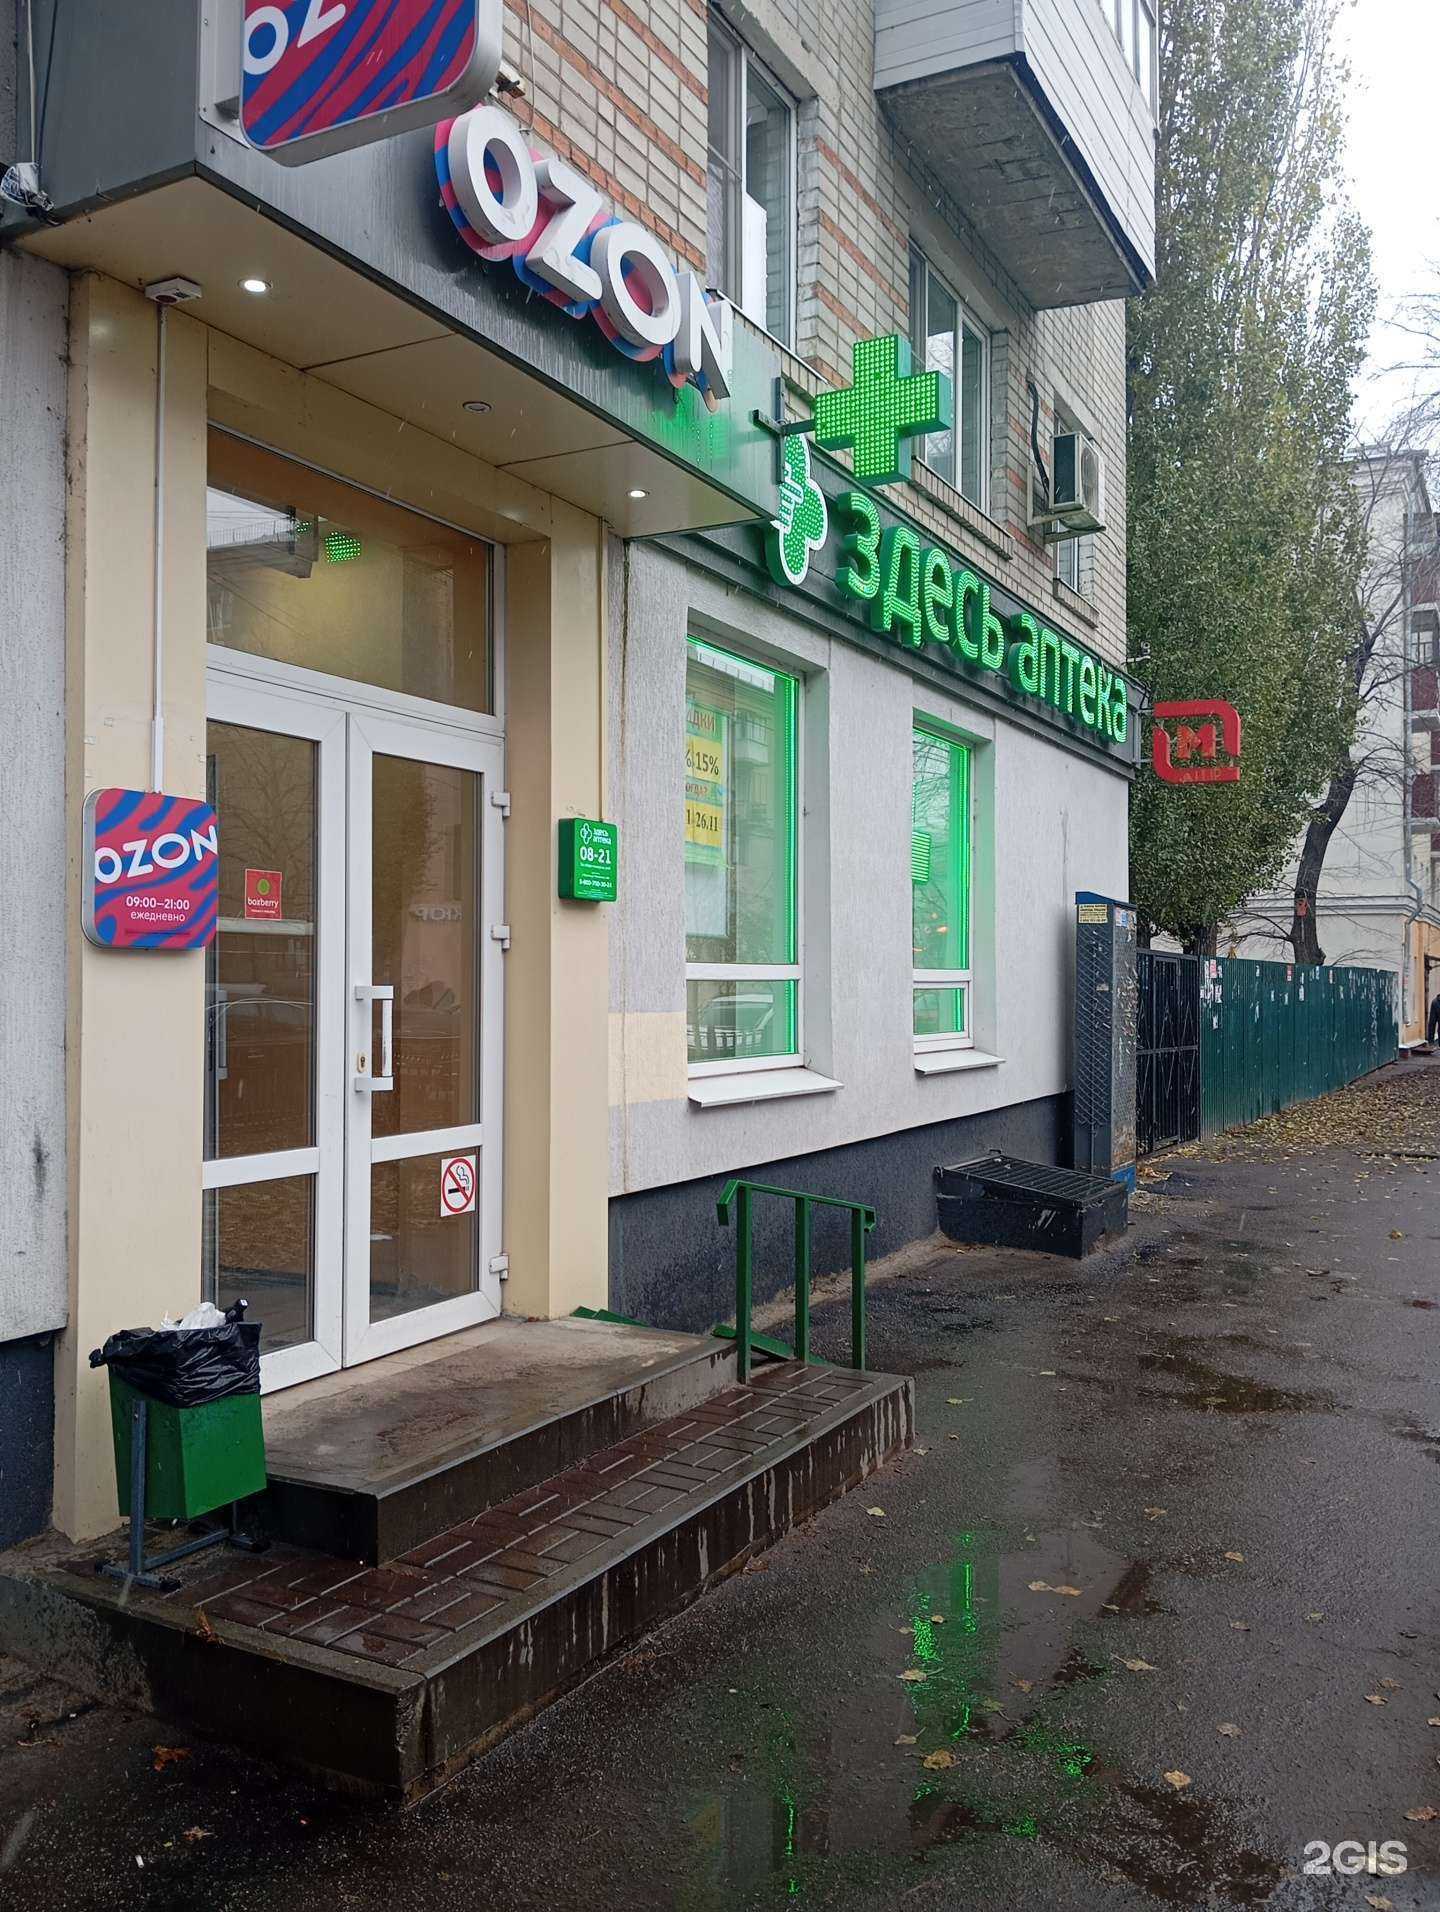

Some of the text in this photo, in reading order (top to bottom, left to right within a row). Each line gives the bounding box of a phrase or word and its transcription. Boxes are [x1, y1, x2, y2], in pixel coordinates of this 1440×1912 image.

[446, 105, 734, 401] OZON
[836, 490, 1128, 744] Здесь аптека
[695, 752, 719, 775] 15%
[695, 811, 718, 831] 26.11
[94, 825, 218, 884] OZON
[579, 846, 612, 864] 08-21
[247, 897, 279, 908] boxberry
[130, 911, 186, 922] ежедневно
